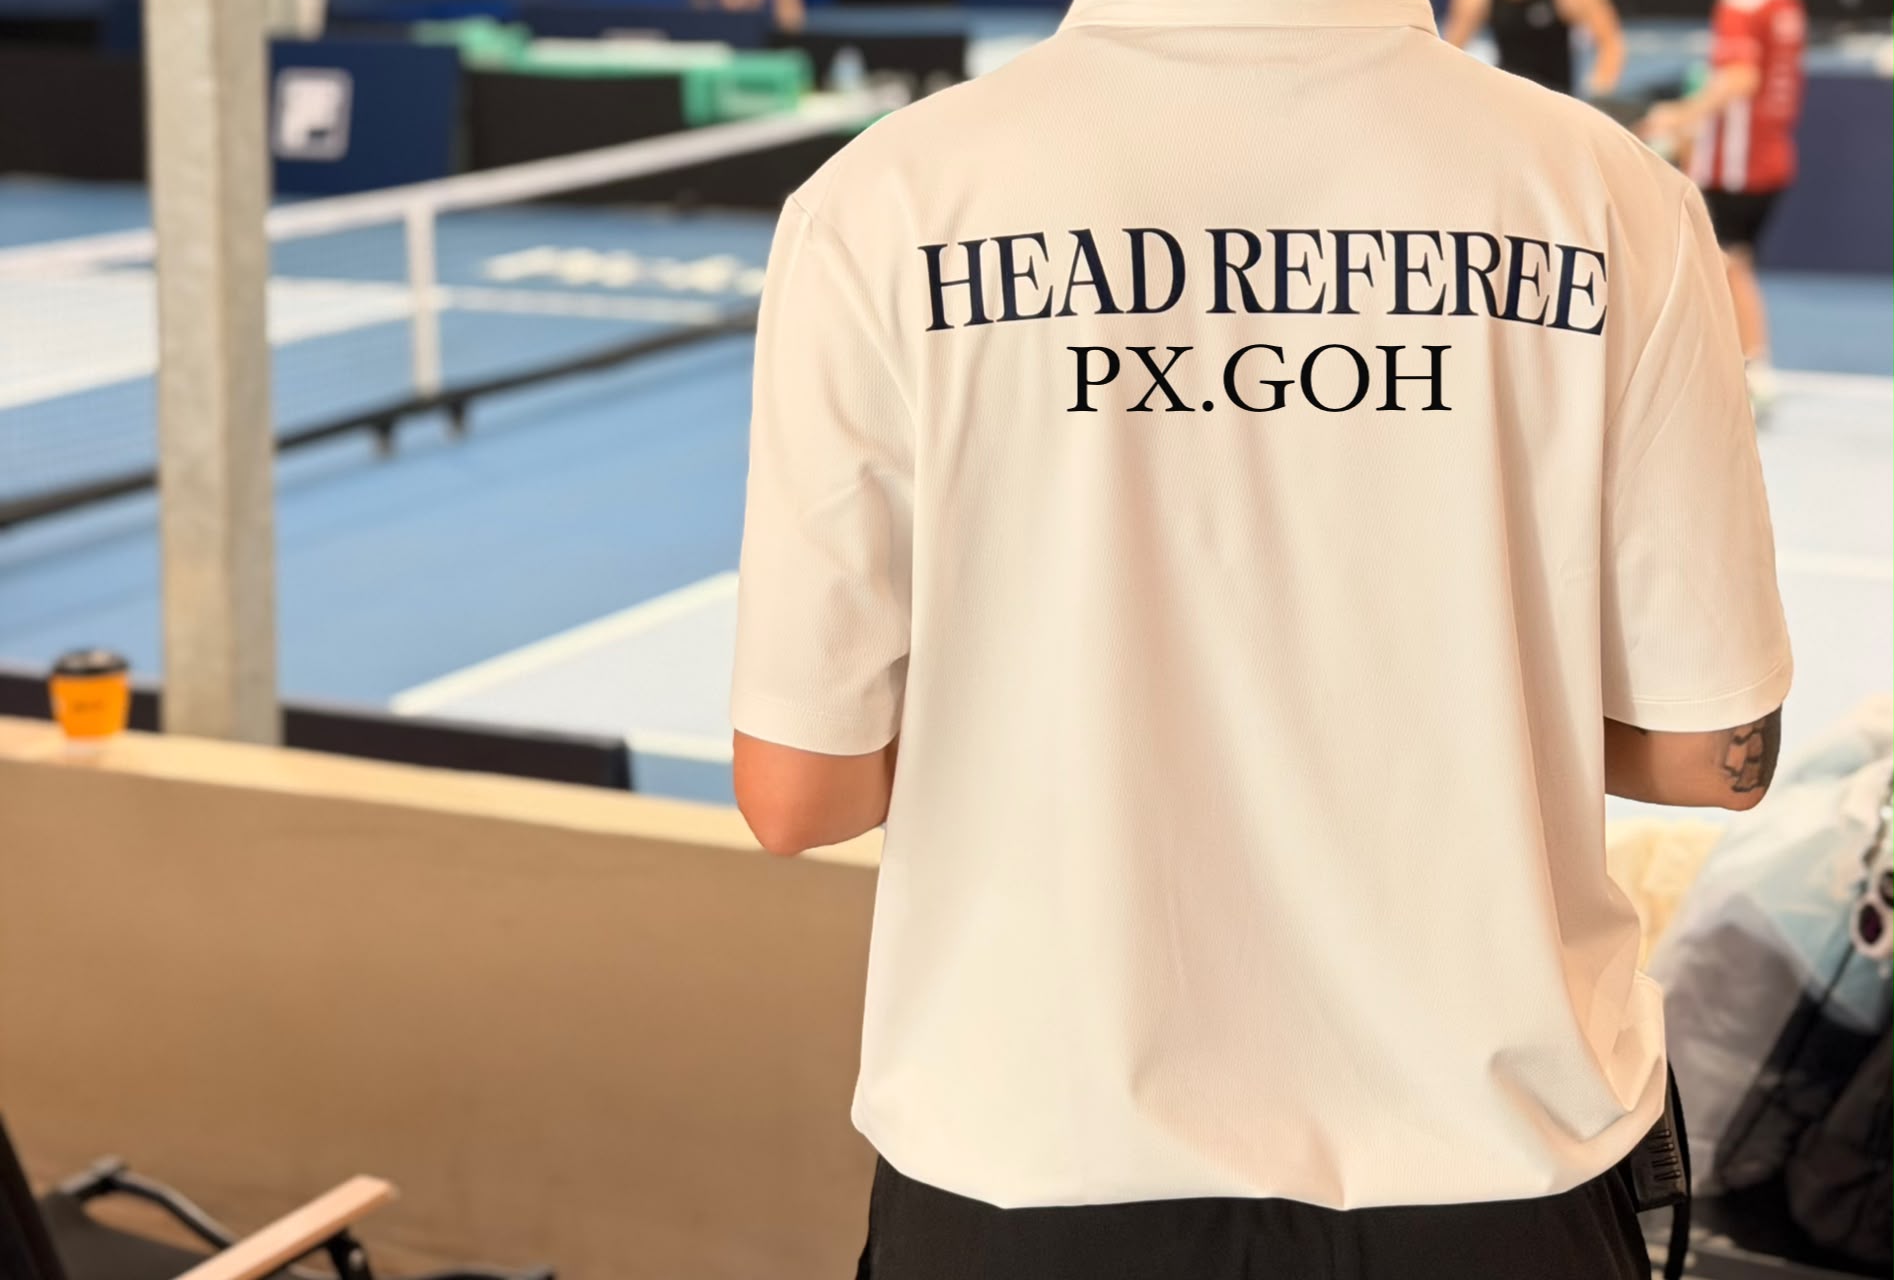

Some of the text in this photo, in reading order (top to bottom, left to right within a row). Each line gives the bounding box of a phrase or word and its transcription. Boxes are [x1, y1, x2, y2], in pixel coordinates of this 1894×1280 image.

[917, 227, 1608, 337] HEAD REFEREE
[1066, 343, 1453, 413] PX.GOH
